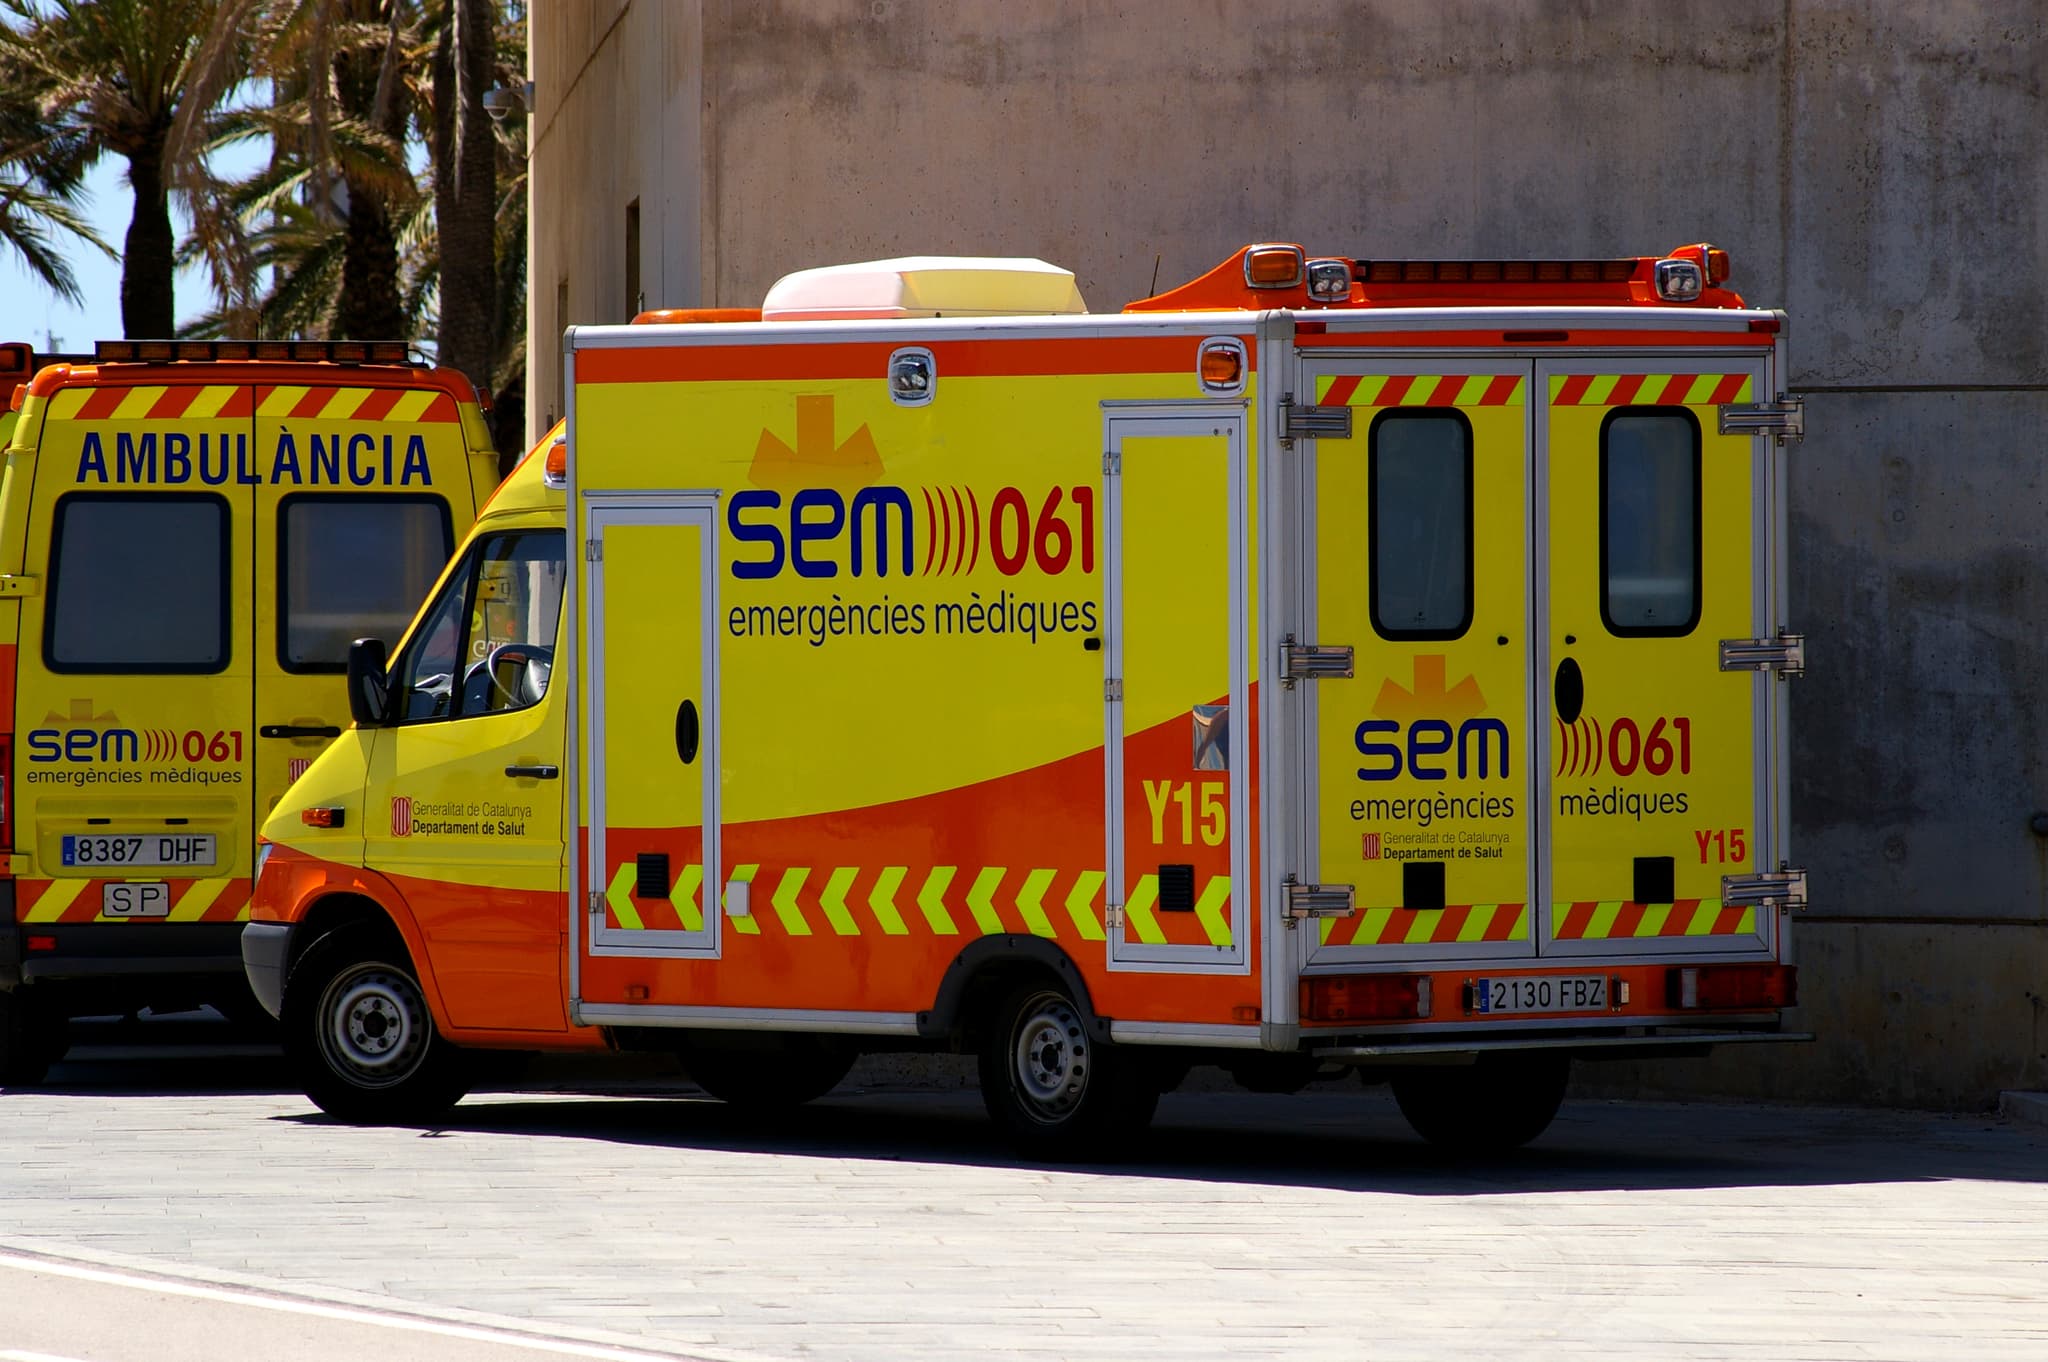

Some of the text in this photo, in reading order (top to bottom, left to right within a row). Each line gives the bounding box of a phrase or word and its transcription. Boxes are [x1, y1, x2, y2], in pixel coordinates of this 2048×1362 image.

[76, 425, 432, 486] AMBULÀNCIA
[727, 485, 1094, 579] sem 061
[728, 590, 1097, 647] emergències mèdiques
[28, 729, 242, 763] sem 061
[1354, 717, 1691, 781] sem 061
[27, 767, 242, 787] emergències mèdiques
[412, 800, 532, 820] Generalitat de Catalunya
[1142, 780, 1226, 846] Y15
[1350, 786, 1688, 827] emergències mèdiques
[412, 820, 525, 836] Departament de Salut
[1383, 830, 1510, 845] Generalitat de Catalunya
[78, 838, 207, 863] 8387 DHF
[1383, 846, 1503, 861] Departament de Salut
[1695, 829, 1746, 864] Y15
[1494, 979, 1601, 1009] 2130 FBZ
